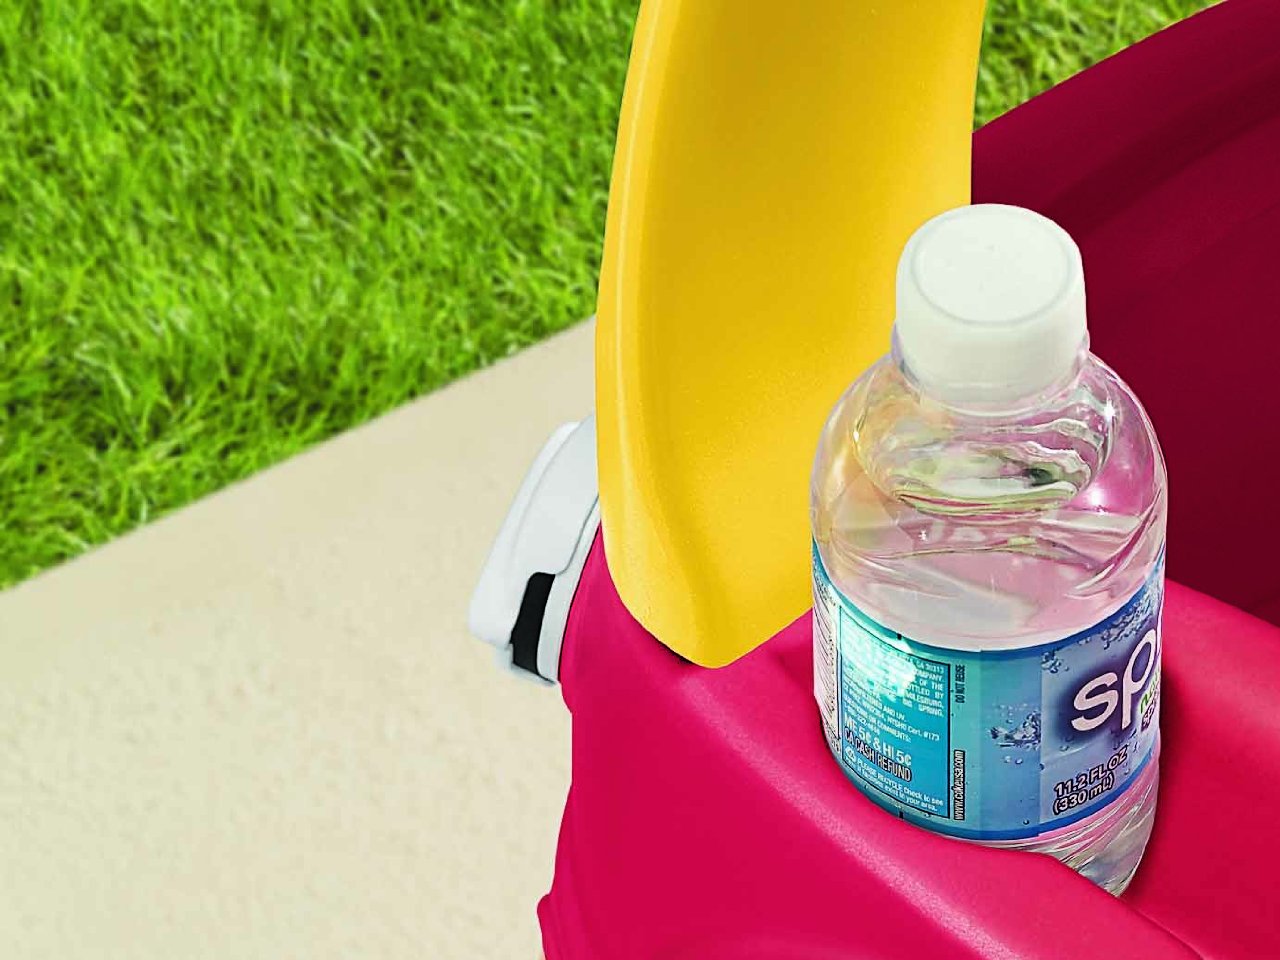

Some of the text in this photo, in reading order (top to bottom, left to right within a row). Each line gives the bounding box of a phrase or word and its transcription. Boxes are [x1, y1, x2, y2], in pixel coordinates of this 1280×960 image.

[855, 736, 876, 763] CASH
[876, 754, 912, 782] REFUND
[882, 741, 895, 758] HI
[954, 750, 965, 820] www.cokeusa.com
[1052, 773, 1115, 815] (330 mL)
[1053, 774, 1088, 798] 11.2
[1107, 748, 1129, 771] OZ
